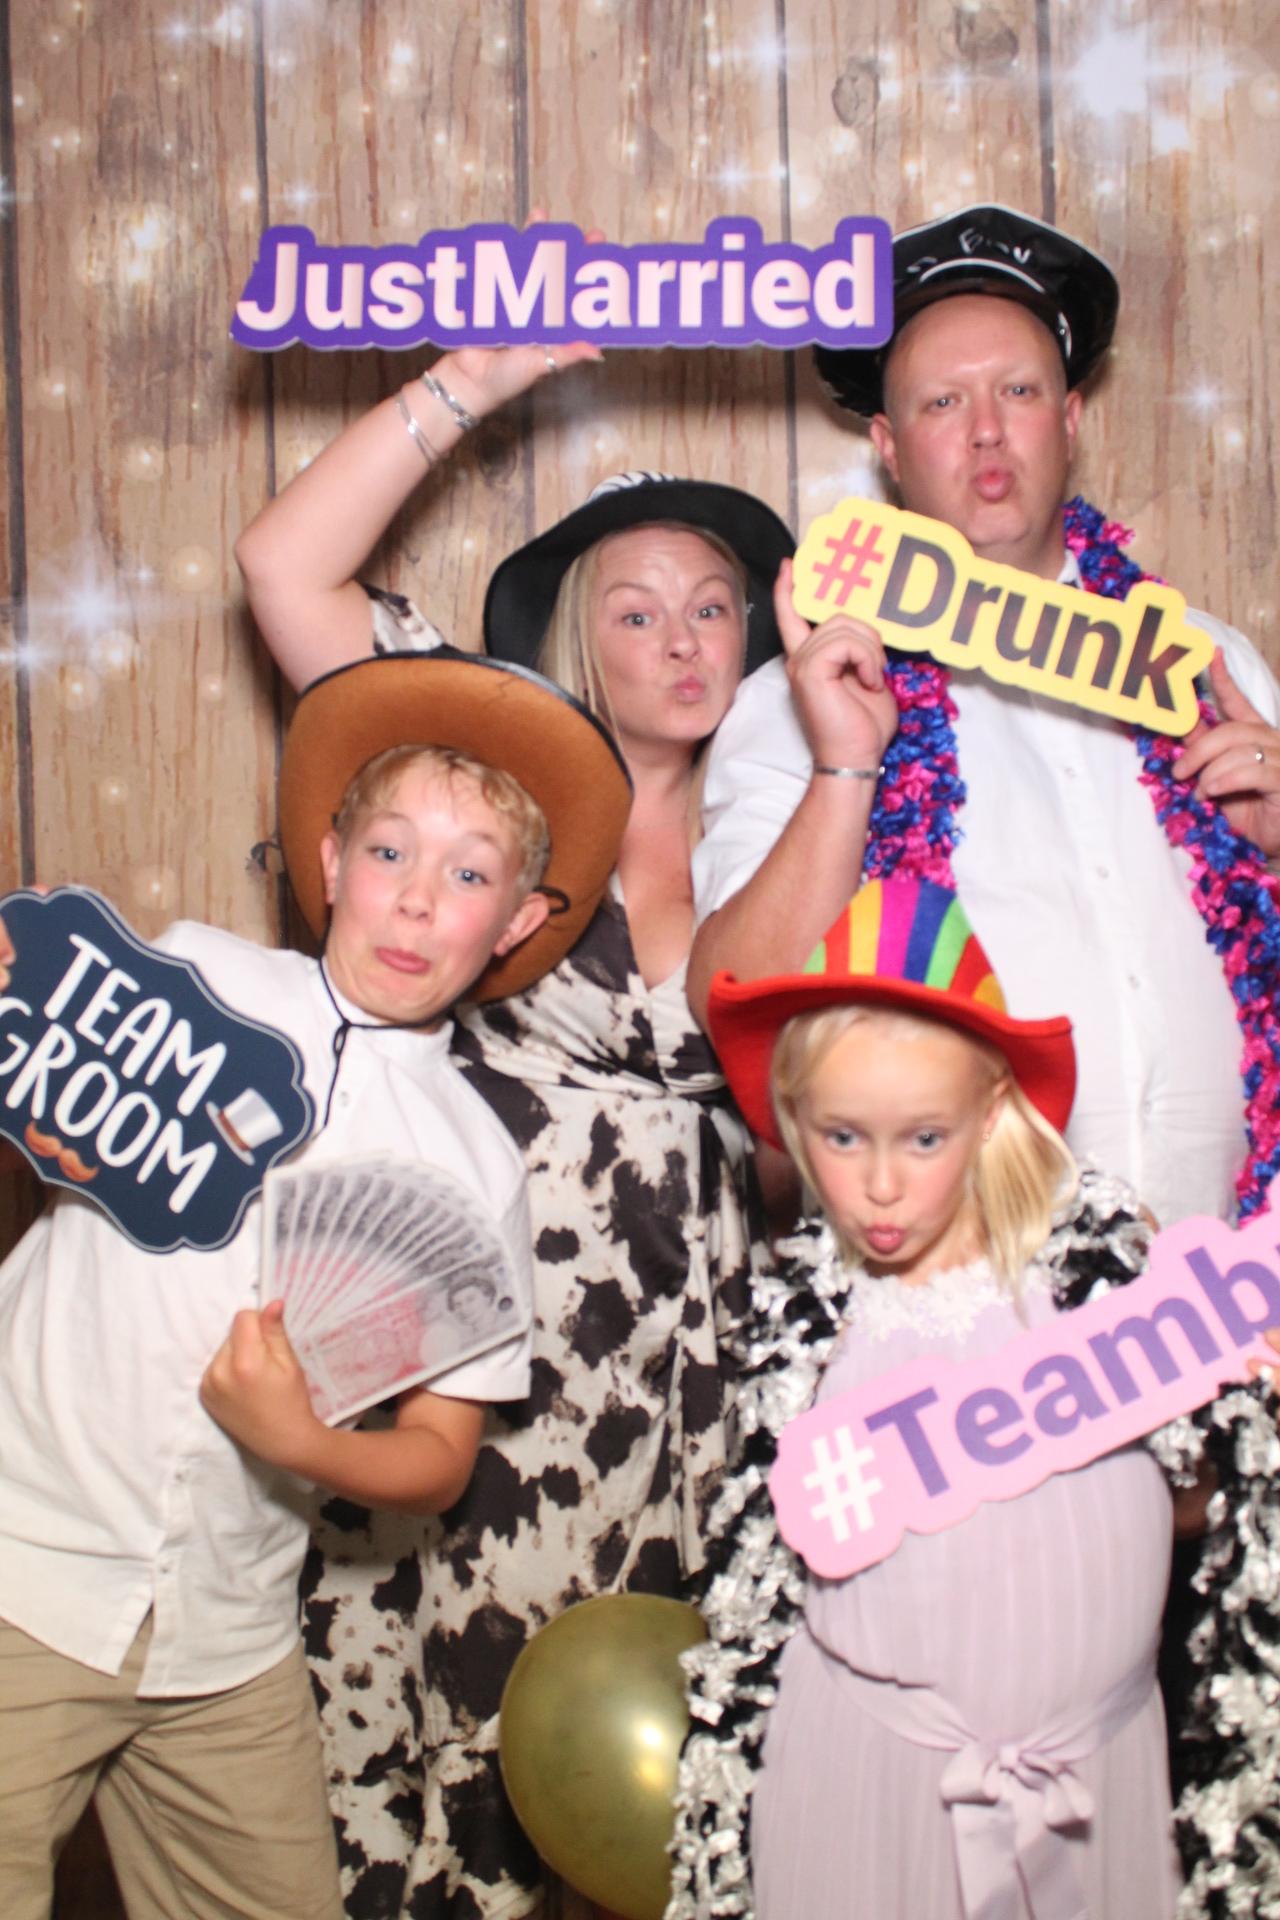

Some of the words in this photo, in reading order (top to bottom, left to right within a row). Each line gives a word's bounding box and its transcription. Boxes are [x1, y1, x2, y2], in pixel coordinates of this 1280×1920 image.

[236, 233, 875, 331] JustMarried
[812, 518, 1191, 713] #Drunk
[0, 996, 217, 1213] GROOM
[44, 934, 227, 1117] TEAM
[803, 1243, 1280, 1544] #Teamb
